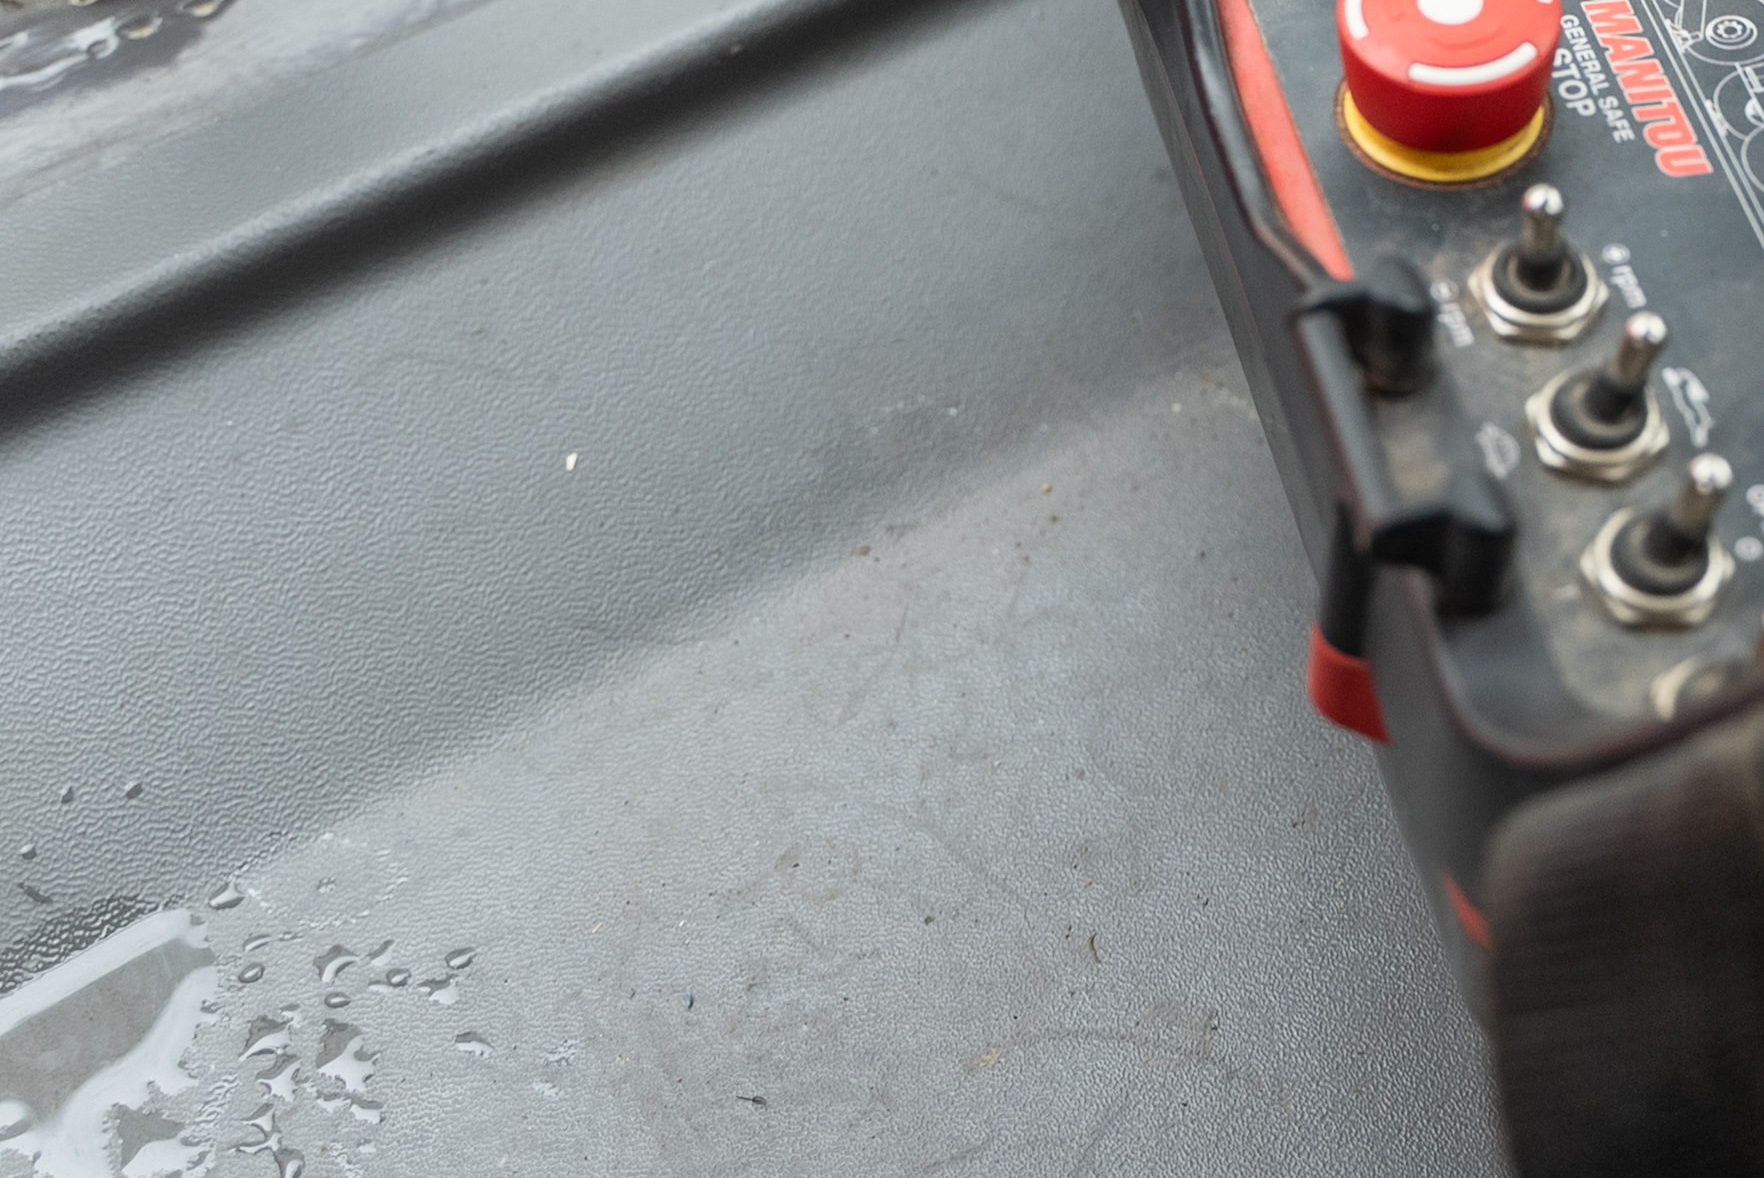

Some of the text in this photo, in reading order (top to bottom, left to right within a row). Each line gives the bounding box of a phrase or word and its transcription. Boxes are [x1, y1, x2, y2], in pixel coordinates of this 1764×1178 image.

[1551, 47, 1597, 117] STOP
[1560, 14, 1636, 144] GENERAL SAFE
